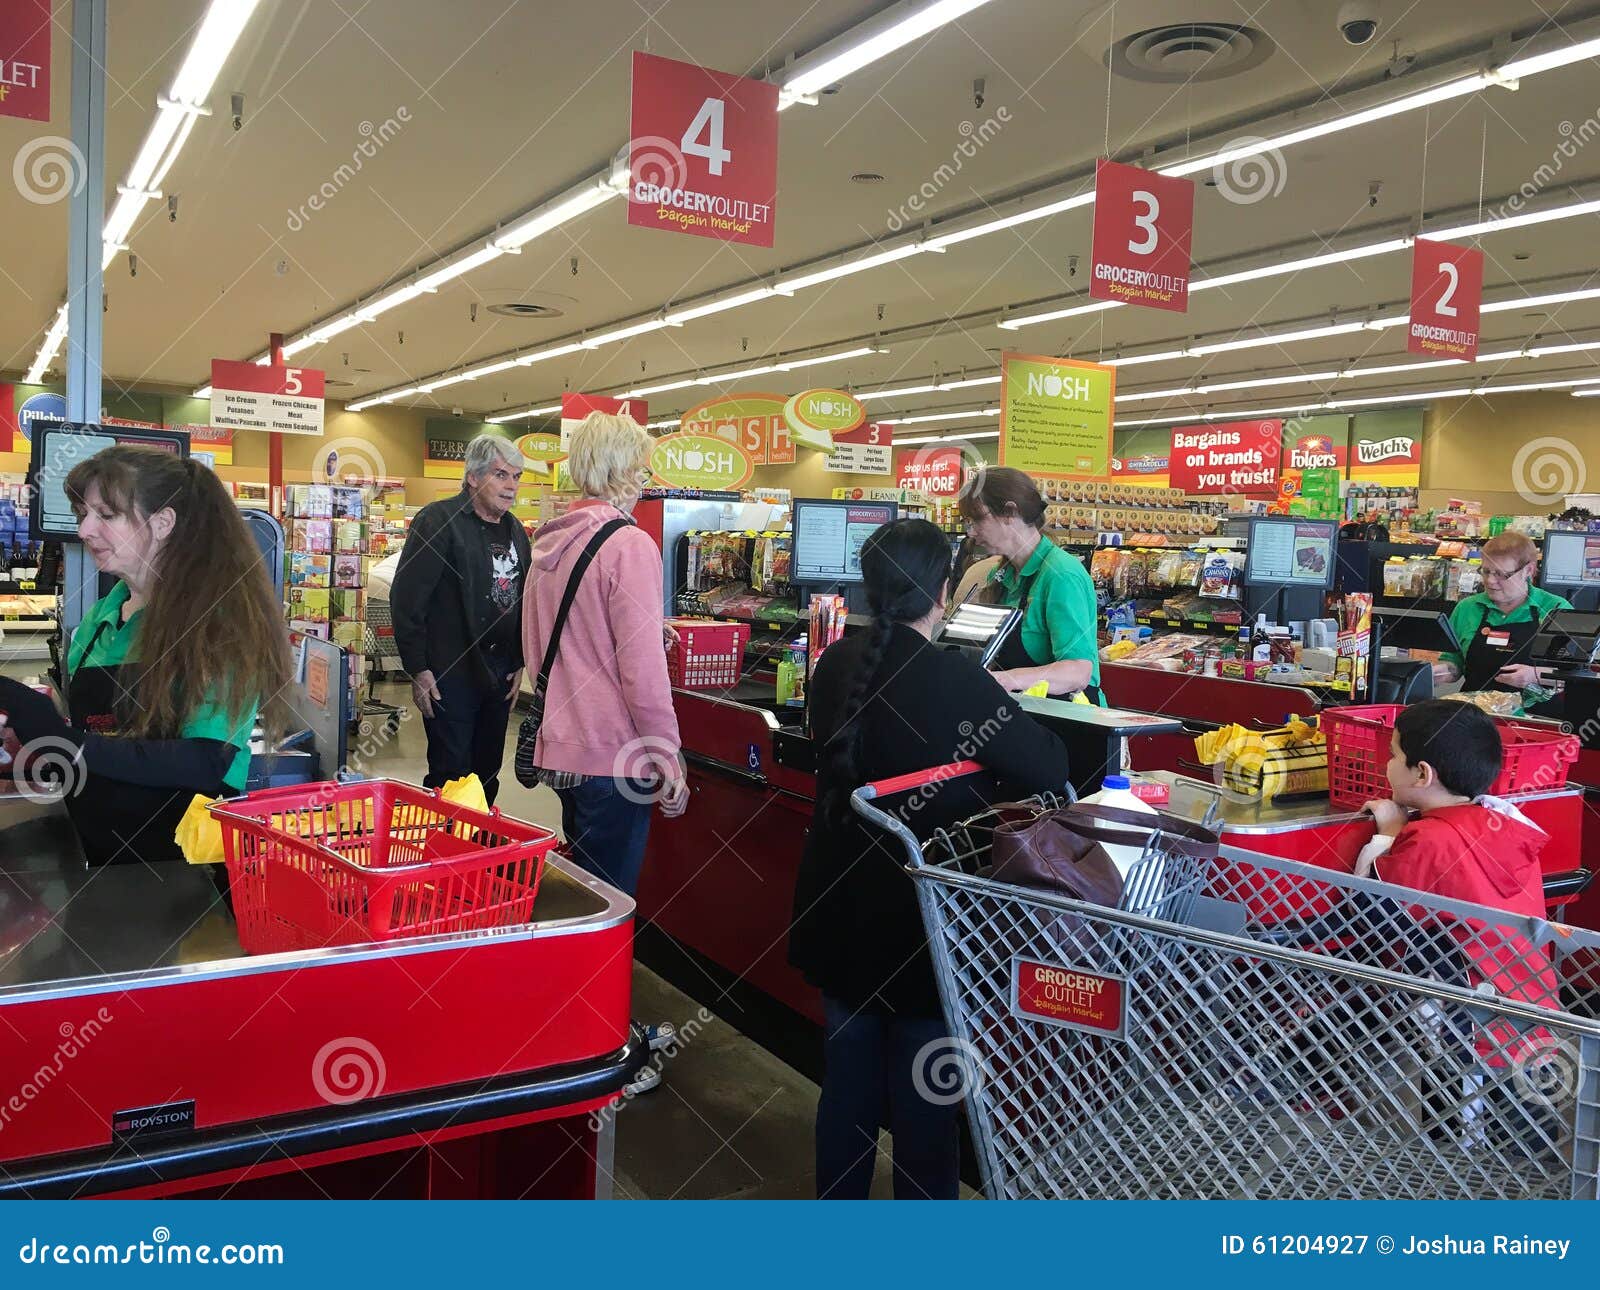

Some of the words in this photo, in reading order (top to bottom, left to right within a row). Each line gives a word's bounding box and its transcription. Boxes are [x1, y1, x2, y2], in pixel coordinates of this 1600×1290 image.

[681, 97, 731, 176] 4
[656, 203, 707, 230] bargain
[711, 215, 752, 234] market
[1128, 190, 1160, 255] 3
[1109, 281, 1143, 300] bargain
[1145, 288, 1174, 302] market
[1435, 262, 1459, 317] 2
[285, 368, 303, 395] 5
[1027, 369, 1091, 401] NOSH
[236, 396, 257, 405] Cream
[272, 399, 292, 407] Frozen
[293, 401, 317, 410] Chicken
[617, 400, 632, 417] 4
[809, 399, 852, 418] NOSH
[288, 411, 303, 419] Meat
[272, 421, 292, 429] Frozen
[294, 423, 318, 431] Seafood
[868, 424, 880, 444] 3
[1174, 430, 1241, 450] Bargains
[1360, 439, 1409, 460] Welch's
[666, 445, 734, 474] NOSH
[904, 463, 920, 473] shop
[922, 463, 931, 472] us
[1186, 454, 1205, 467] on
[1209, 448, 1263, 466] brands
[1291, 449, 1337, 470] Folgers
[899, 477, 920, 489] GET
[922, 476, 955, 492] MORE
[1197, 473, 1226, 490] you
[1230, 467, 1276, 485] trust!
[1034, 967, 1105, 994] GROCERY
[1045, 984, 1095, 1008] OUTLET
[1033, 995, 1071, 1015] bargain
[1073, 1005, 1104, 1020] market
[131, 1110, 190, 1128] ROYSTON
